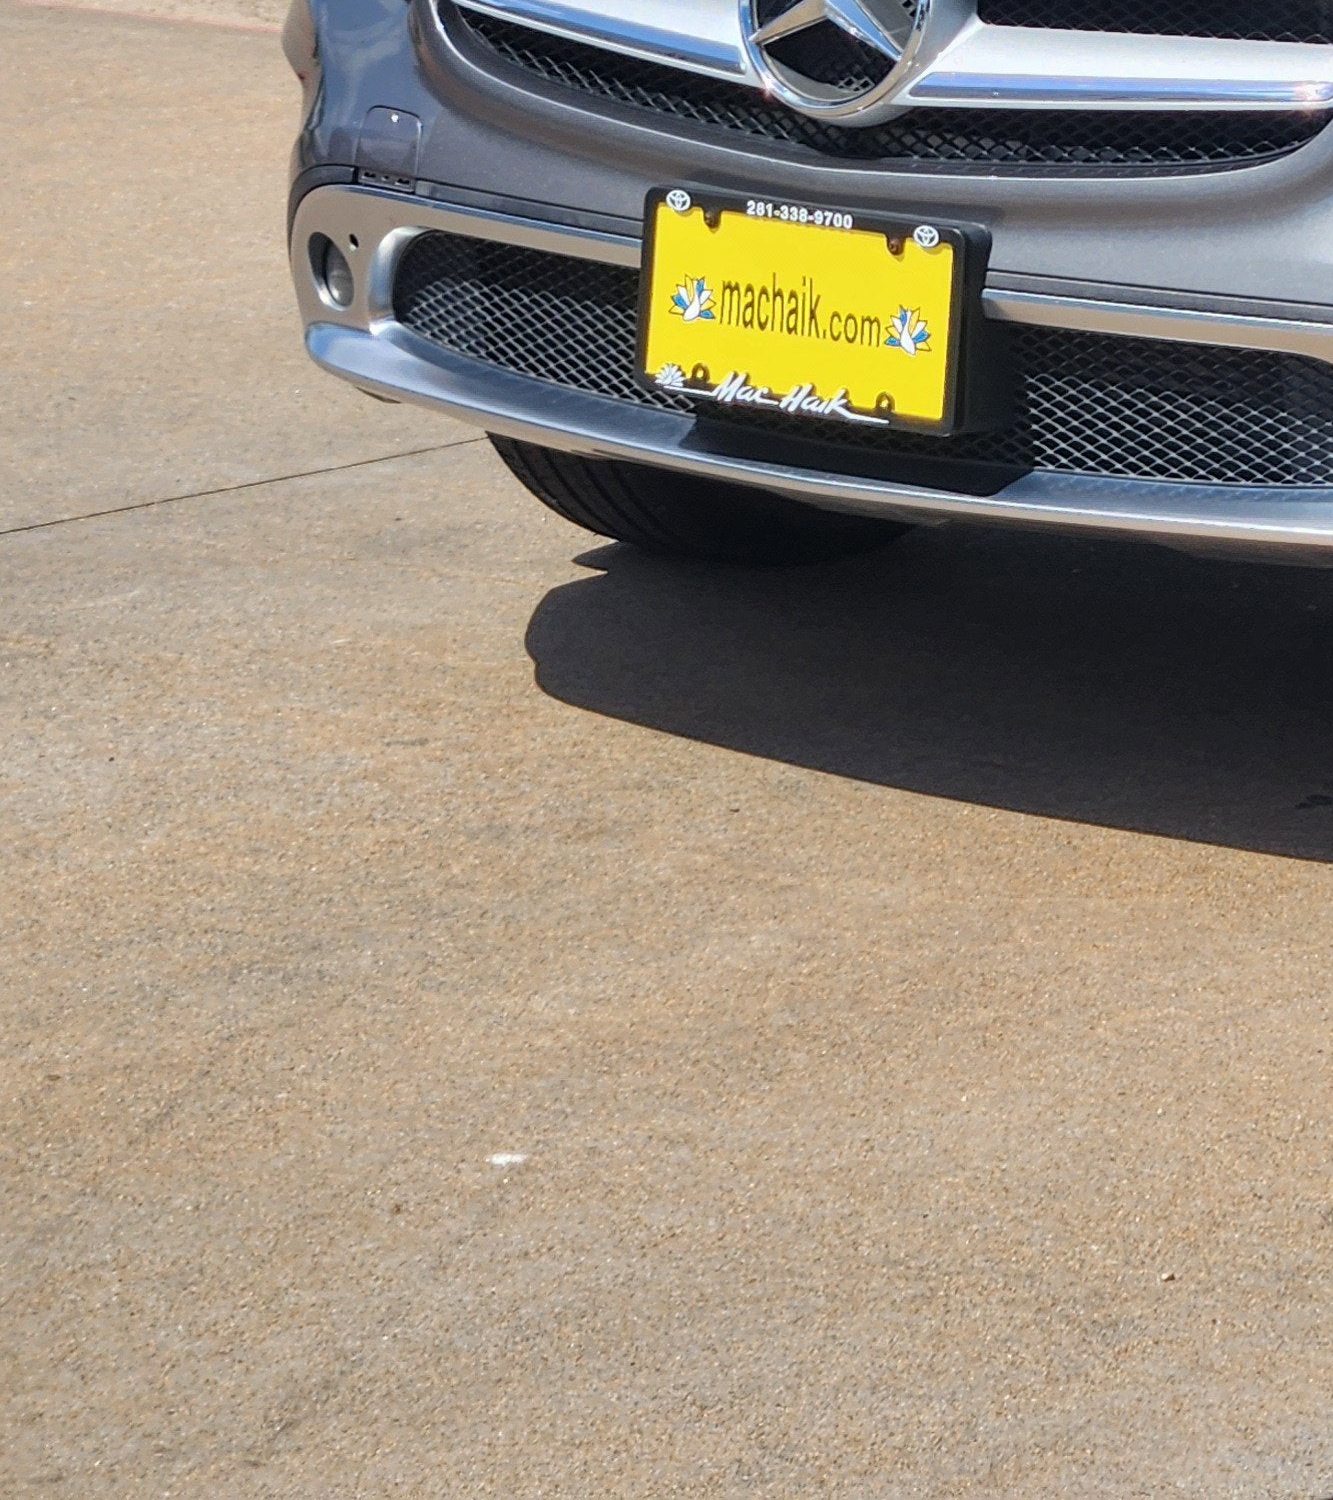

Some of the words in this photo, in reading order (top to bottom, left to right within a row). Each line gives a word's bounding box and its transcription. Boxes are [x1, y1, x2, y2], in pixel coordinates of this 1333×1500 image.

[746, 200, 853, 230] 281-338-9700
[720, 272, 881, 347] machaik.com
[712, 371, 779, 405] Mac
